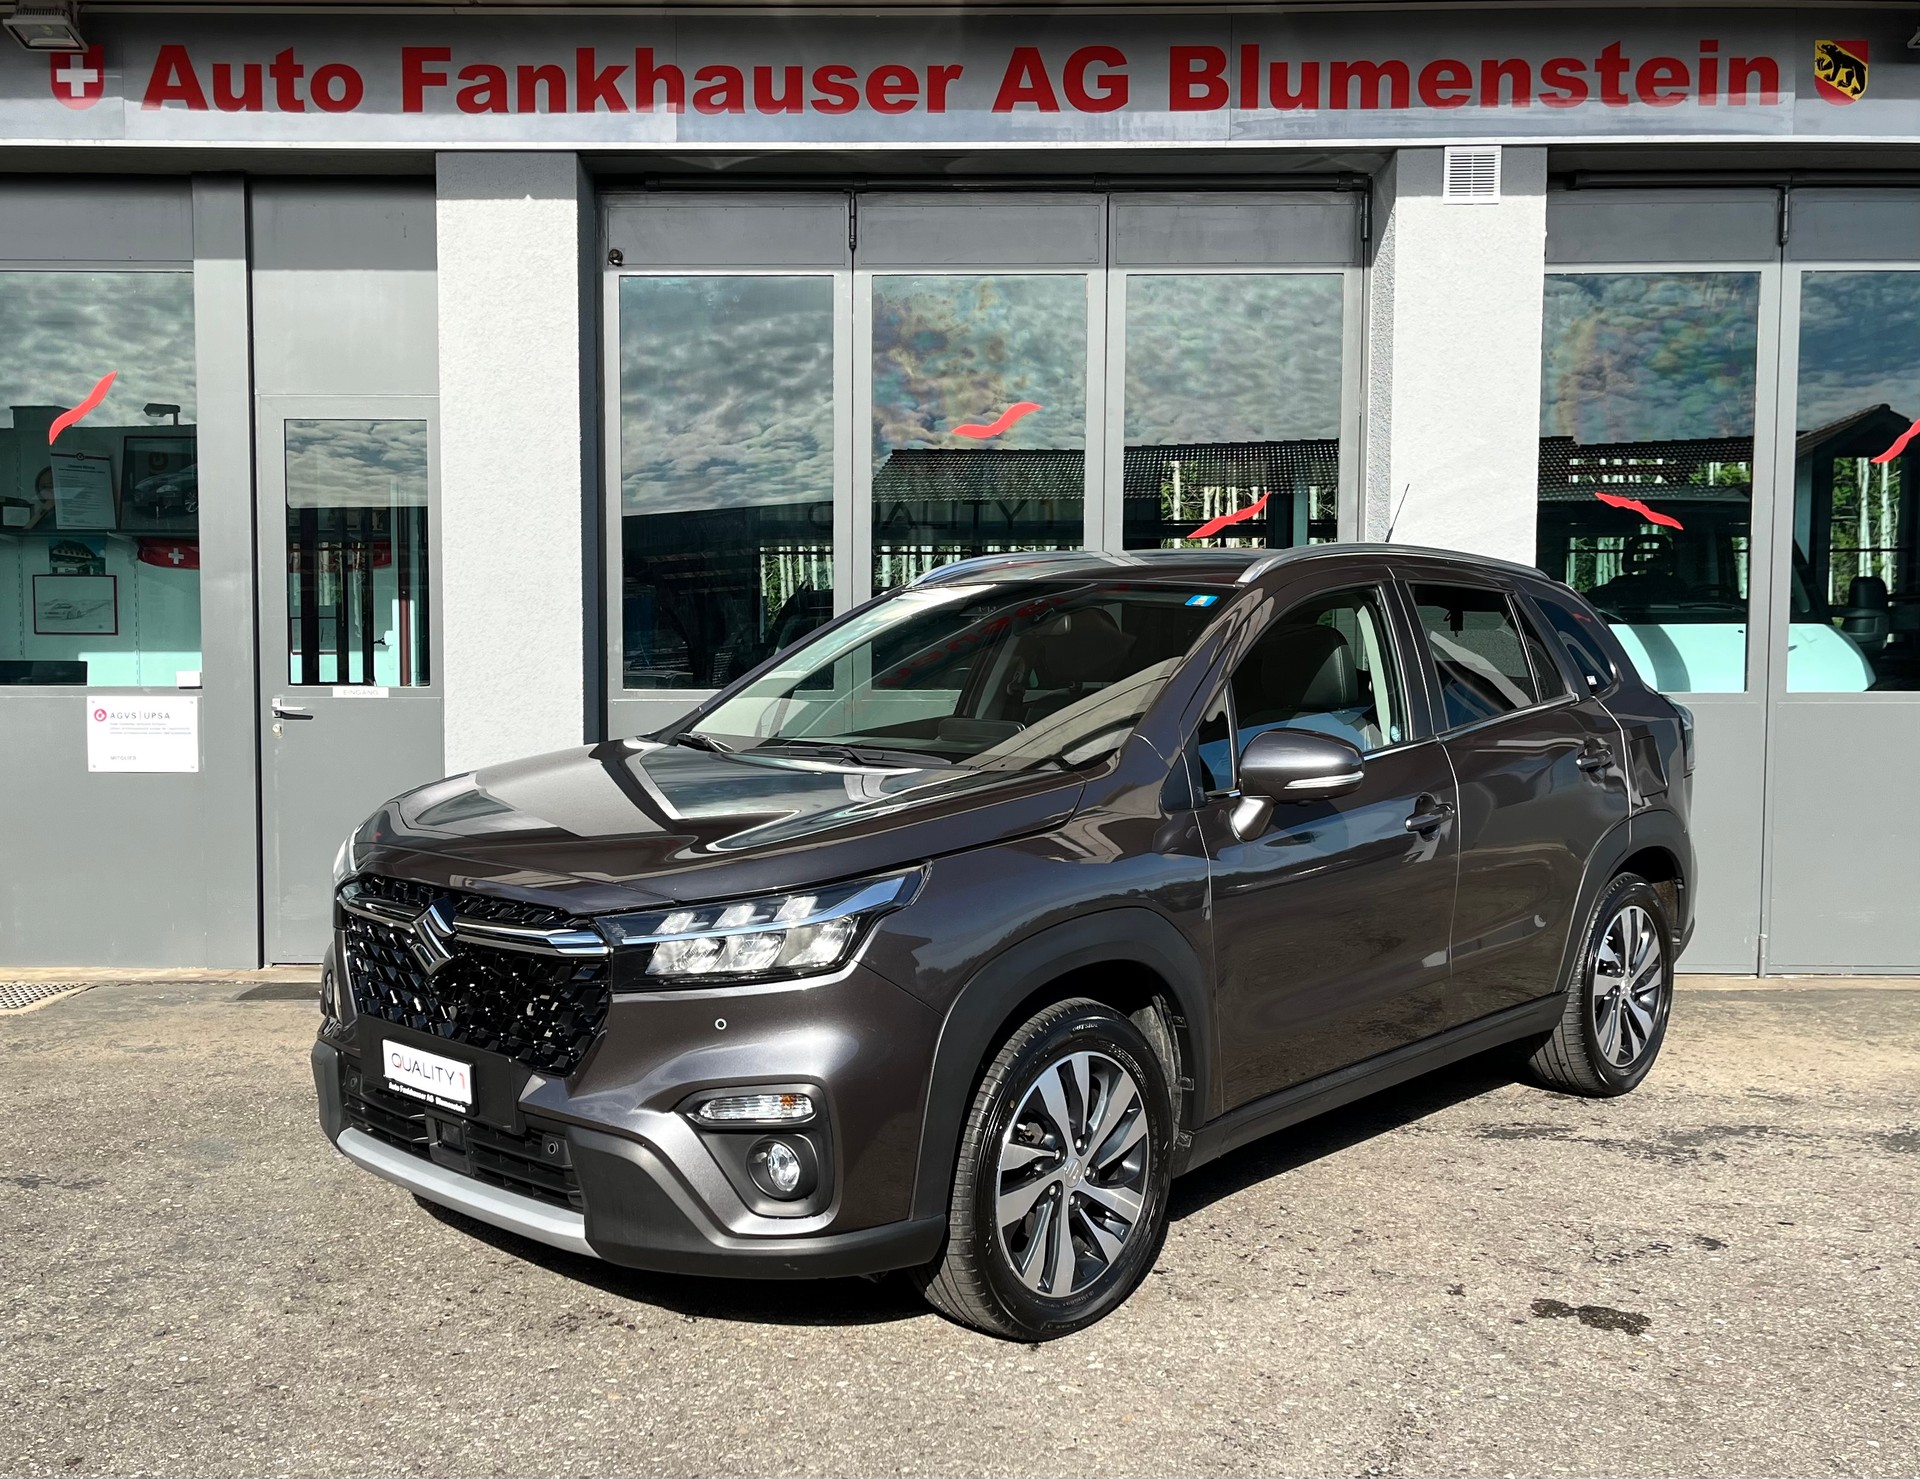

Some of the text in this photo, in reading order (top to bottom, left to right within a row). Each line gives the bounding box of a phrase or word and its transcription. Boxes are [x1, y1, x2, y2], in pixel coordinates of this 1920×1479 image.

[143, 41, 1779, 114] Auto Fankhauser AG Blumenstein
[110, 712, 171, 720] AGVS UPSA
